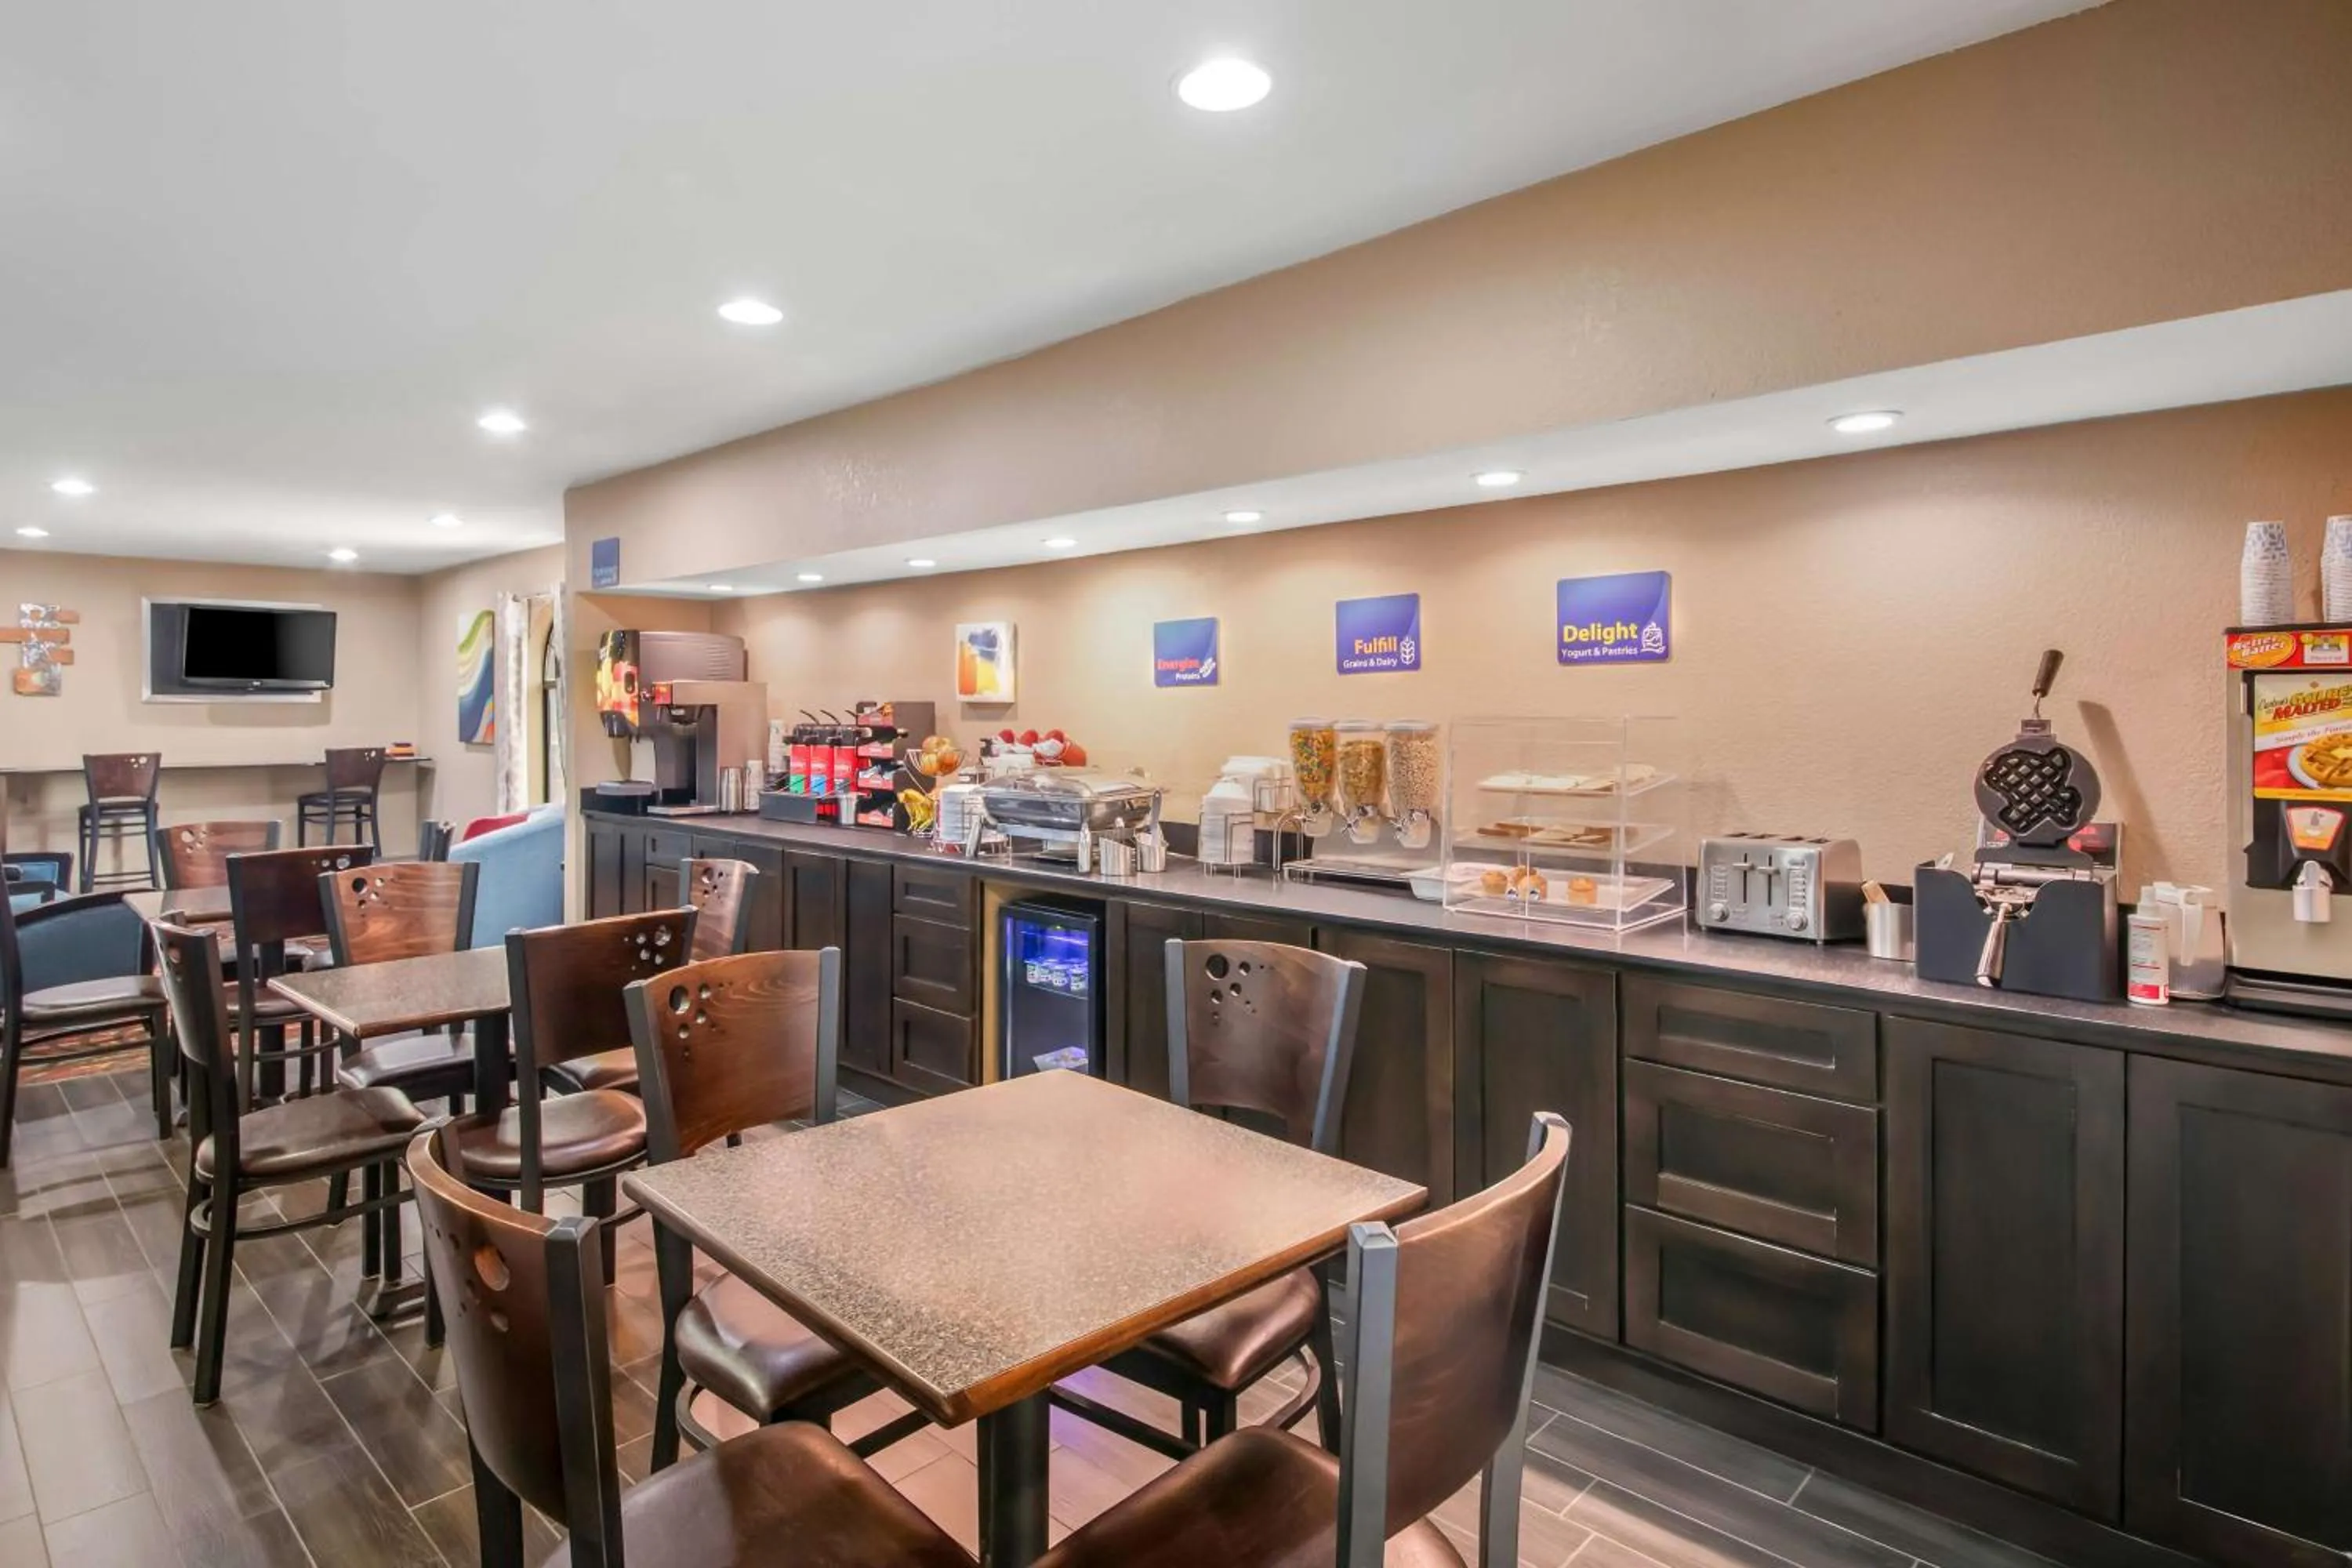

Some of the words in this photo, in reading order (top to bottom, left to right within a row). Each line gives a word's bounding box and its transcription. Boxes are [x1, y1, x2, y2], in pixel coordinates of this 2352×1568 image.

[1563, 622, 1638, 644] Delight
[1354, 636, 1397, 654] Fulfill
[1561, 648, 1592, 659] Yogurt
[1593, 647, 1600, 656] &
[1602, 646, 1638, 656] Pastries
[1343, 659, 1367, 669] Grains
[1369, 658, 1375, 666] &
[1377, 657, 1398, 667] Dairy
